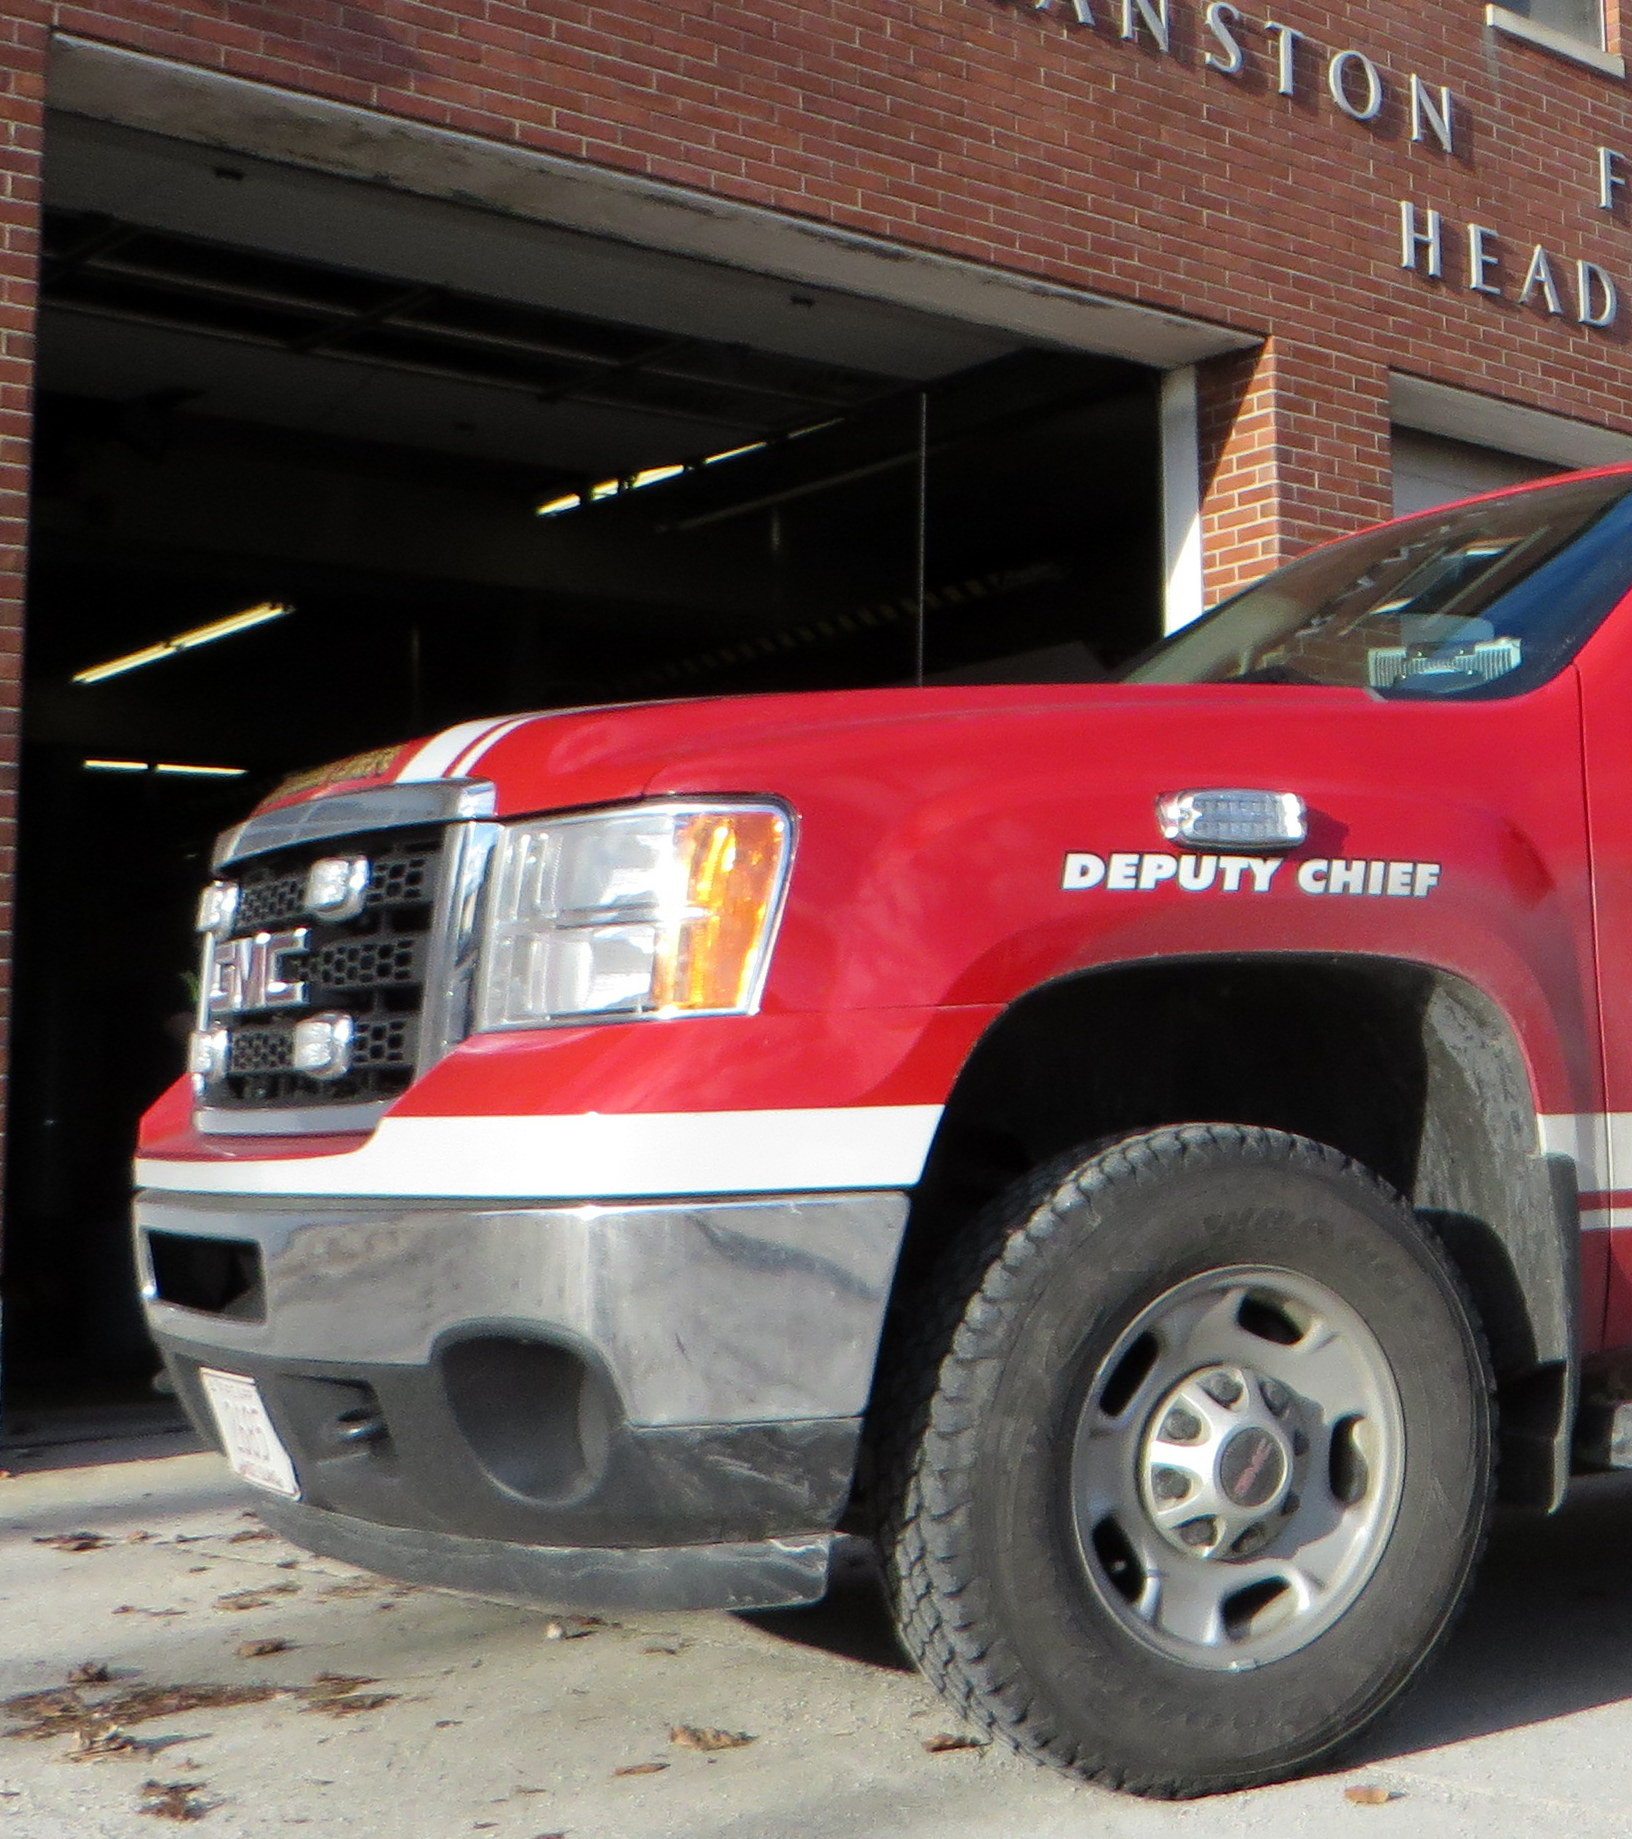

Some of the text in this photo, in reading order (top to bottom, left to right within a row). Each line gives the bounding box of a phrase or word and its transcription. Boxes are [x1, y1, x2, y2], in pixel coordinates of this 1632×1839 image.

[1036, 0, 1454, 153] NSTON
[1061, 851, 1442, 899] DEPUTY CHIEF
[206, 927, 311, 1014] GMC
